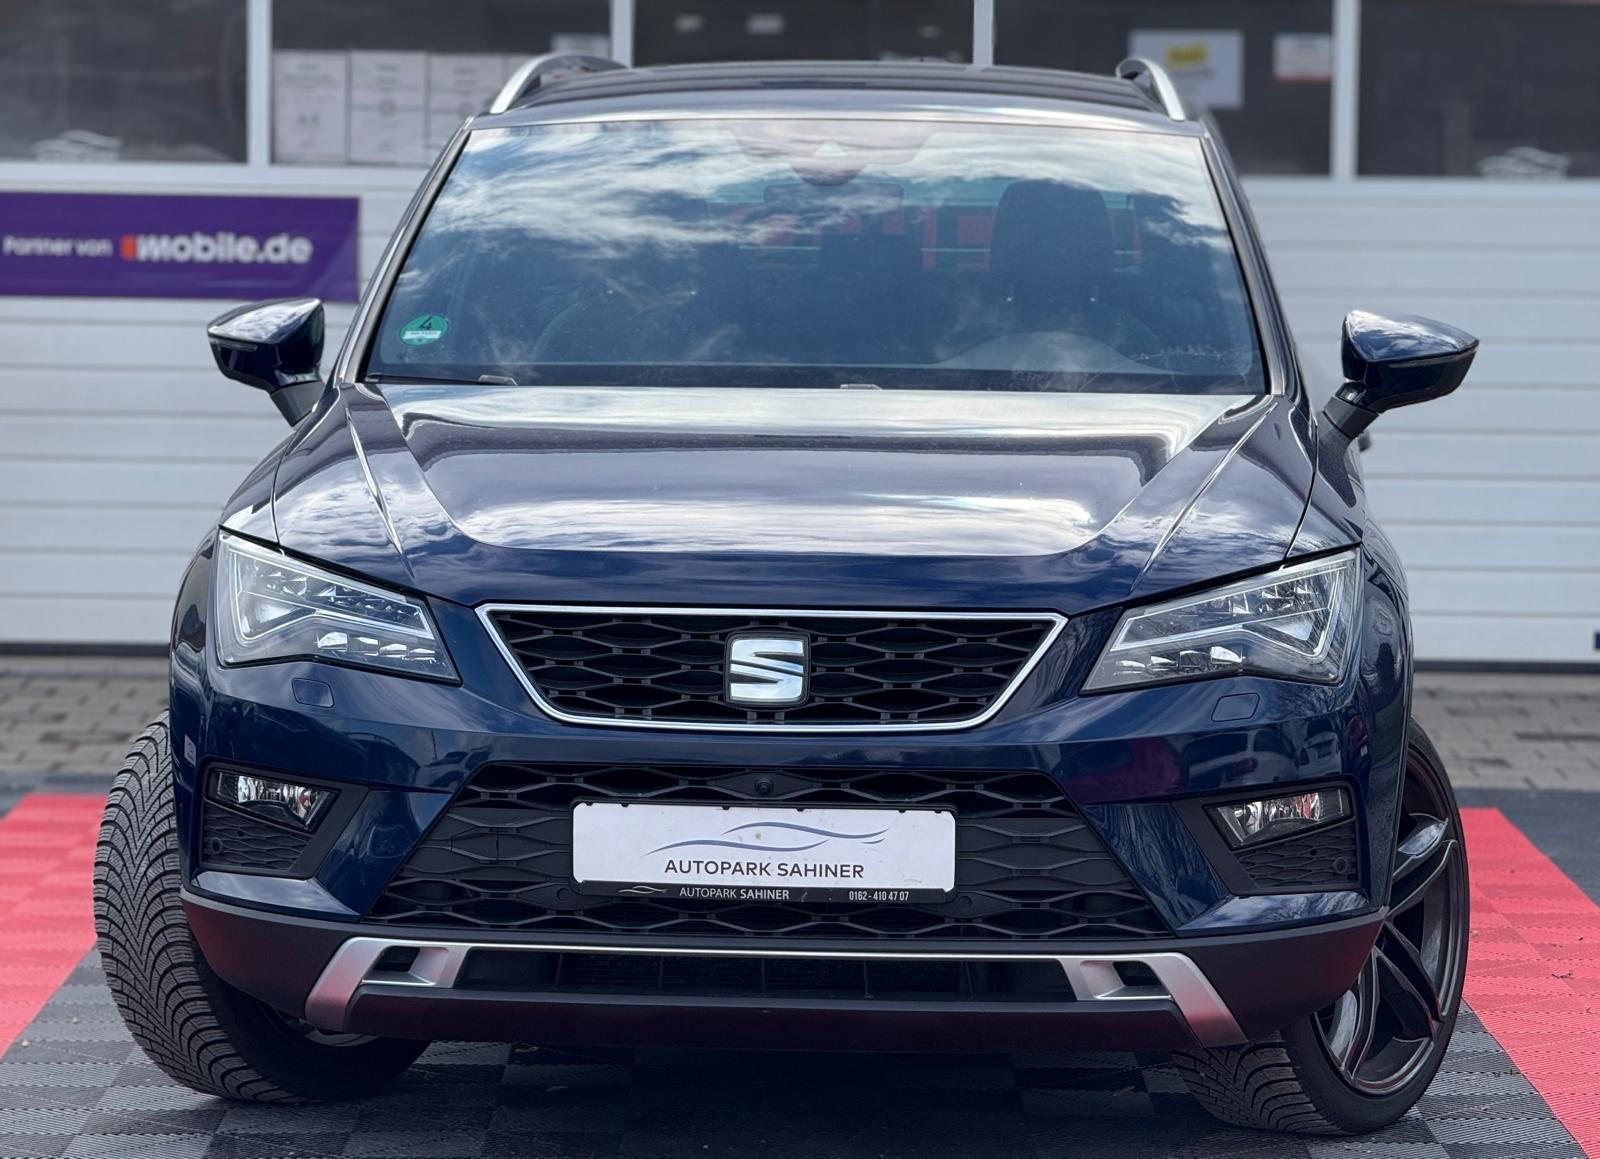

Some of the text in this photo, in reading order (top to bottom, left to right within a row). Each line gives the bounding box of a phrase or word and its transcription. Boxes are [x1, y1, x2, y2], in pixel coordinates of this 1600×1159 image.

[418, 316, 433, 331] 4
[664, 859, 865, 879] AUTOPARK SAHINER
[679, 887, 790, 900] AUTOPARK SAHINER
